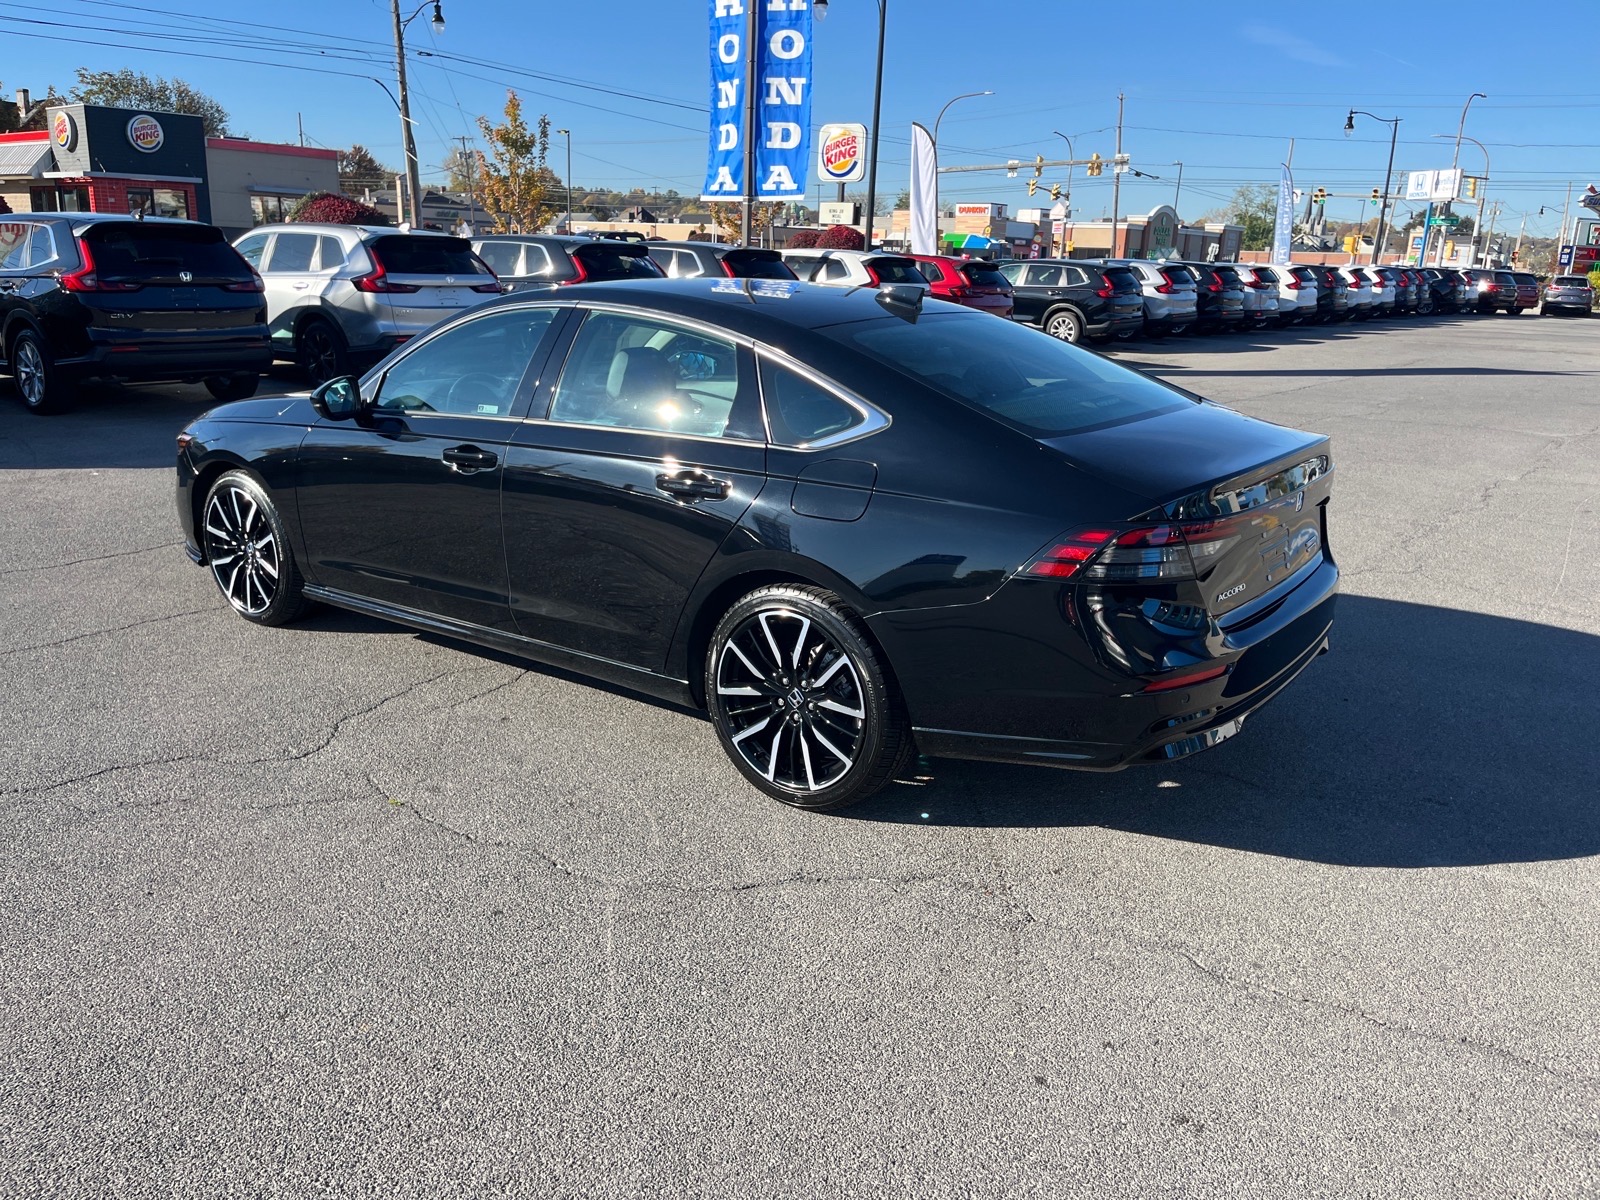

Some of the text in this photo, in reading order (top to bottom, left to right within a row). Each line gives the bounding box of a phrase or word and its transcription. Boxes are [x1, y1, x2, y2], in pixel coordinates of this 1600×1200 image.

[133, 124, 158, 134] BURGER
[134, 130, 159, 142] KING
[825, 136, 857, 155] BURGER
[825, 145, 857, 168] KING
[1217, 582, 1246, 602] ACCORD
